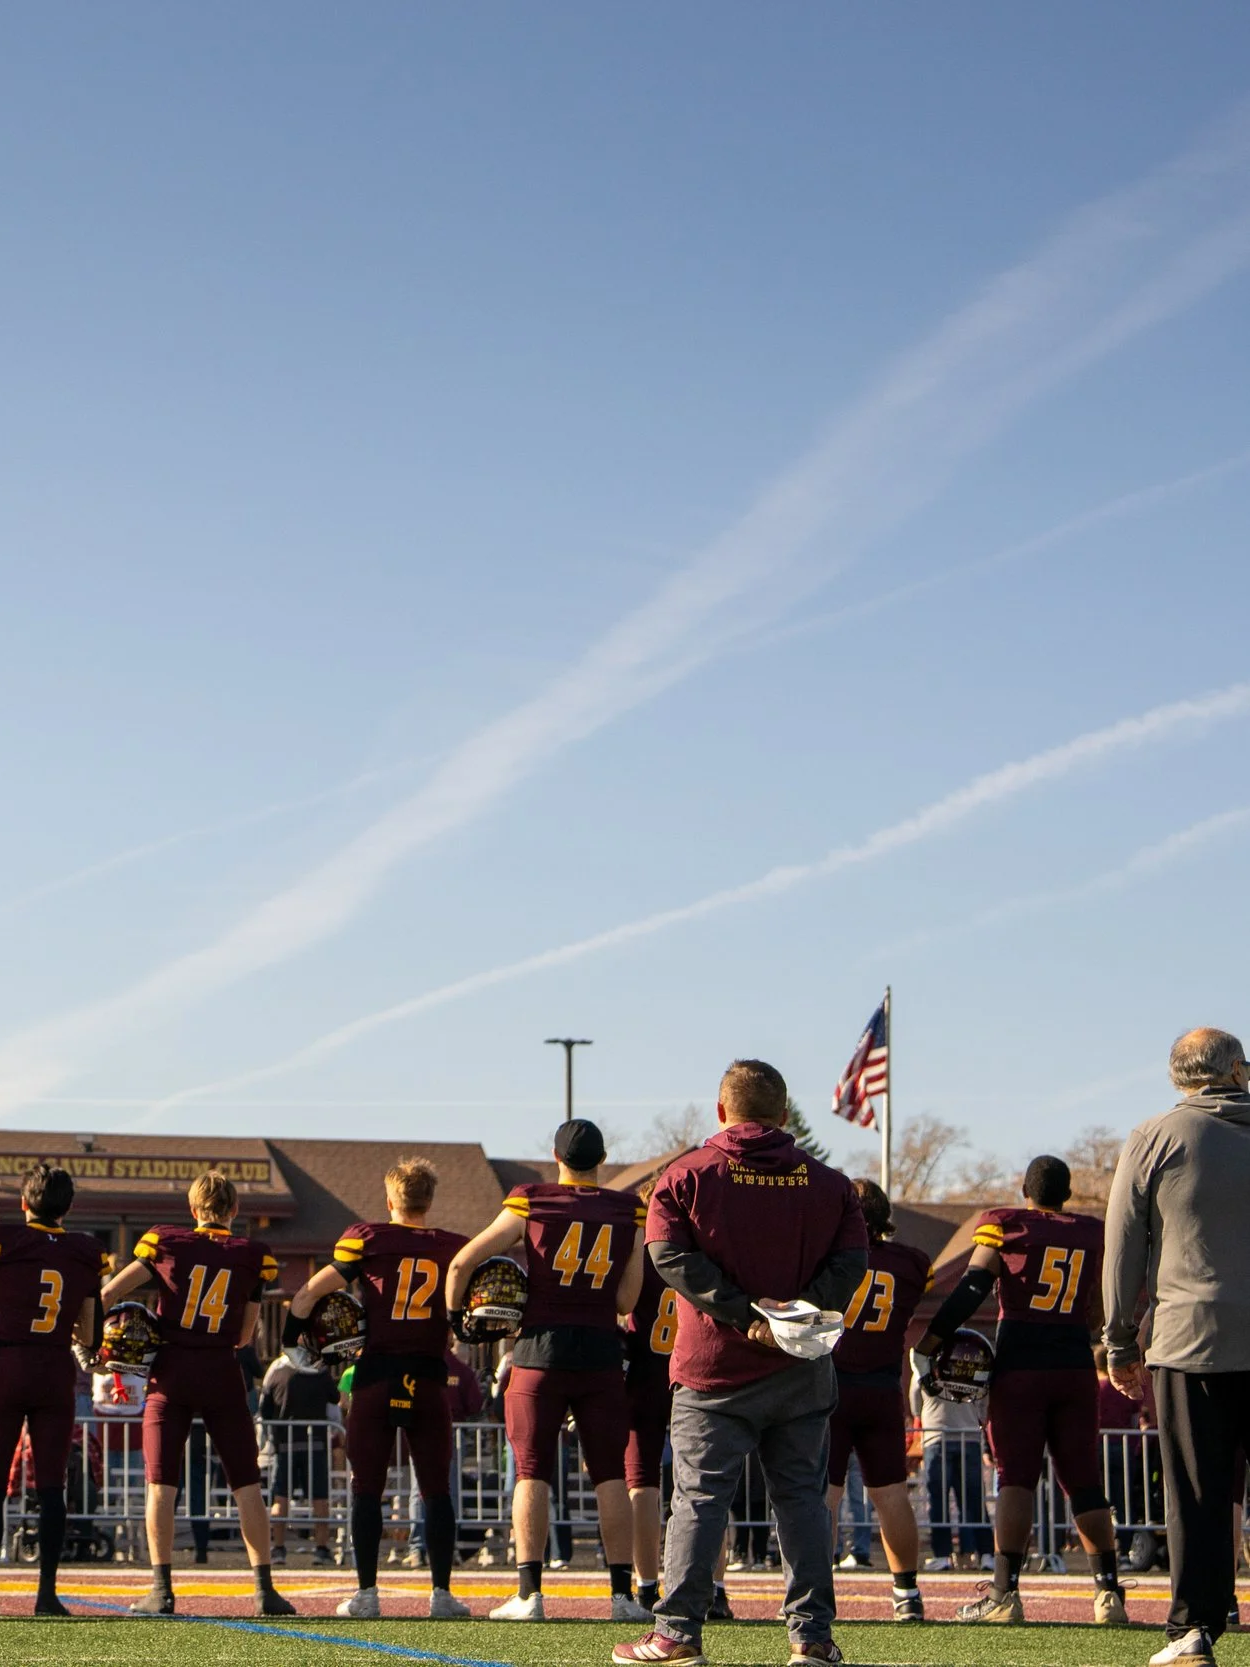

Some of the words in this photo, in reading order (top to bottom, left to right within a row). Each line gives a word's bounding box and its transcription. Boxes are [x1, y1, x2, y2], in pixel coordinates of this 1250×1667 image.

[113, 1159, 210, 1179] STADIUM
[216, 1161, 269, 1181] CLUB
[755, 1175, 765, 1185] '10
[766, 1175, 774, 1186] '11
[775, 1176, 784, 1186] '12
[796, 1176, 809, 1186] '24
[552, 1221, 614, 1290] 44
[1030, 1246, 1086, 1314] 51
[30, 1269, 64, 1333] 3
[180, 1265, 232, 1333] 14
[391, 1257, 440, 1320] 12
[484, 1308, 521, 1318] BRONCOS
